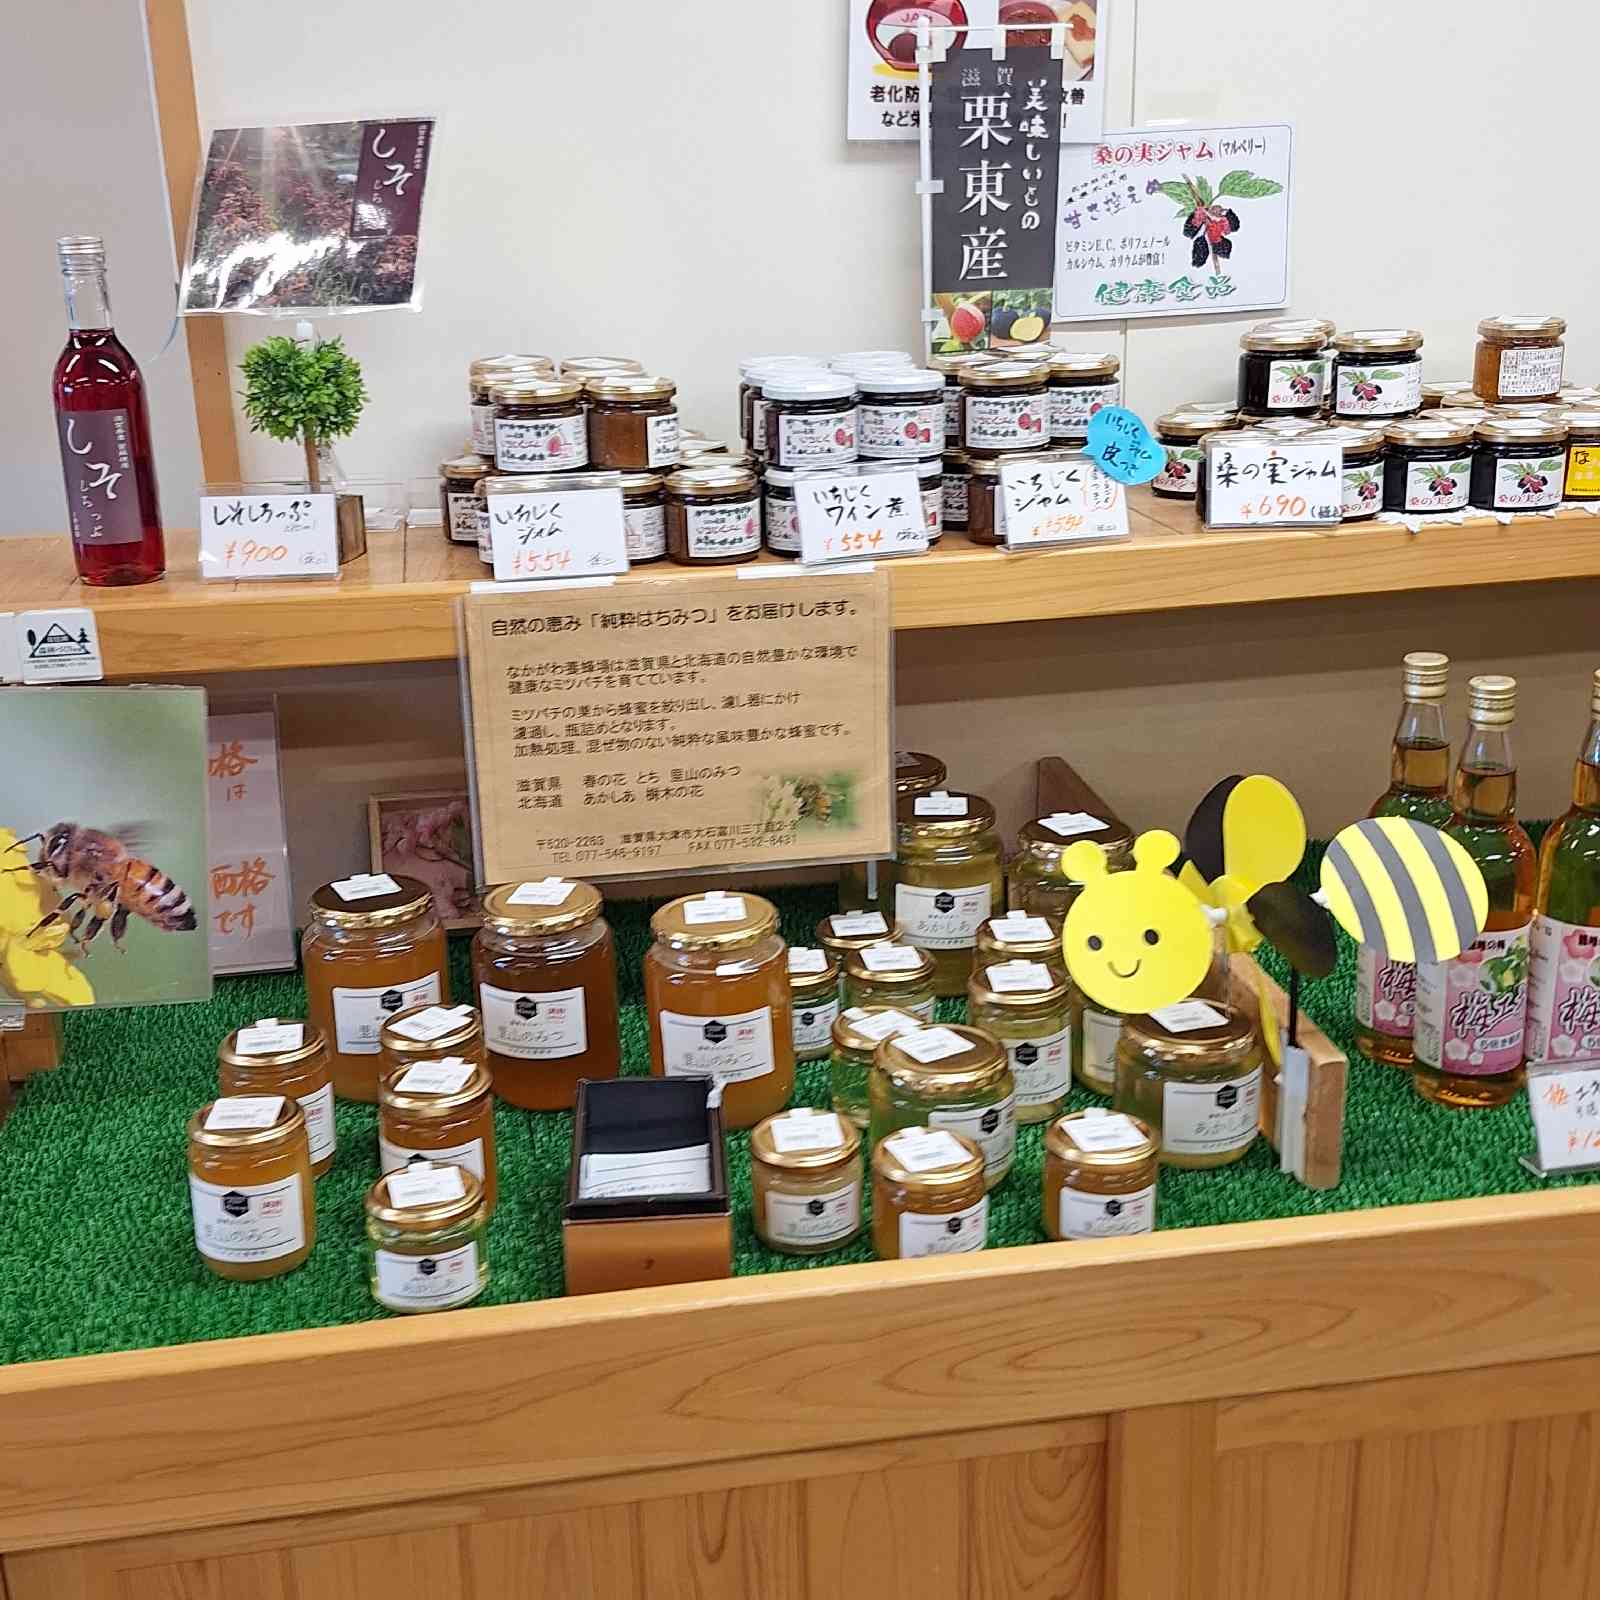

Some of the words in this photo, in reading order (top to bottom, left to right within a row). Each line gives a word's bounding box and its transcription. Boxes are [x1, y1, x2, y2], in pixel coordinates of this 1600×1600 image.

[370, 128, 414, 196] しそ
[1095, 141, 1214, 165] 桑の実ジャム
[957, 91, 1013, 281] 栗東産
[1095, 275, 1236, 305] 健康食品
[67, 418, 123, 500] しそ
[1216, 451, 1337, 489] 桑の実ジャム
[1007, 468, 1082, 493] いちじく
[812, 484, 871, 504] いちじく
[1013, 494, 1072, 513] ジャム
[1239, 493, 1307, 520] ¥690
[494, 501, 563, 526] いちじく
[823, 528, 884, 552] ¥554
[224, 539, 289, 568] ¥900
[511, 550, 572, 574] ¥554
